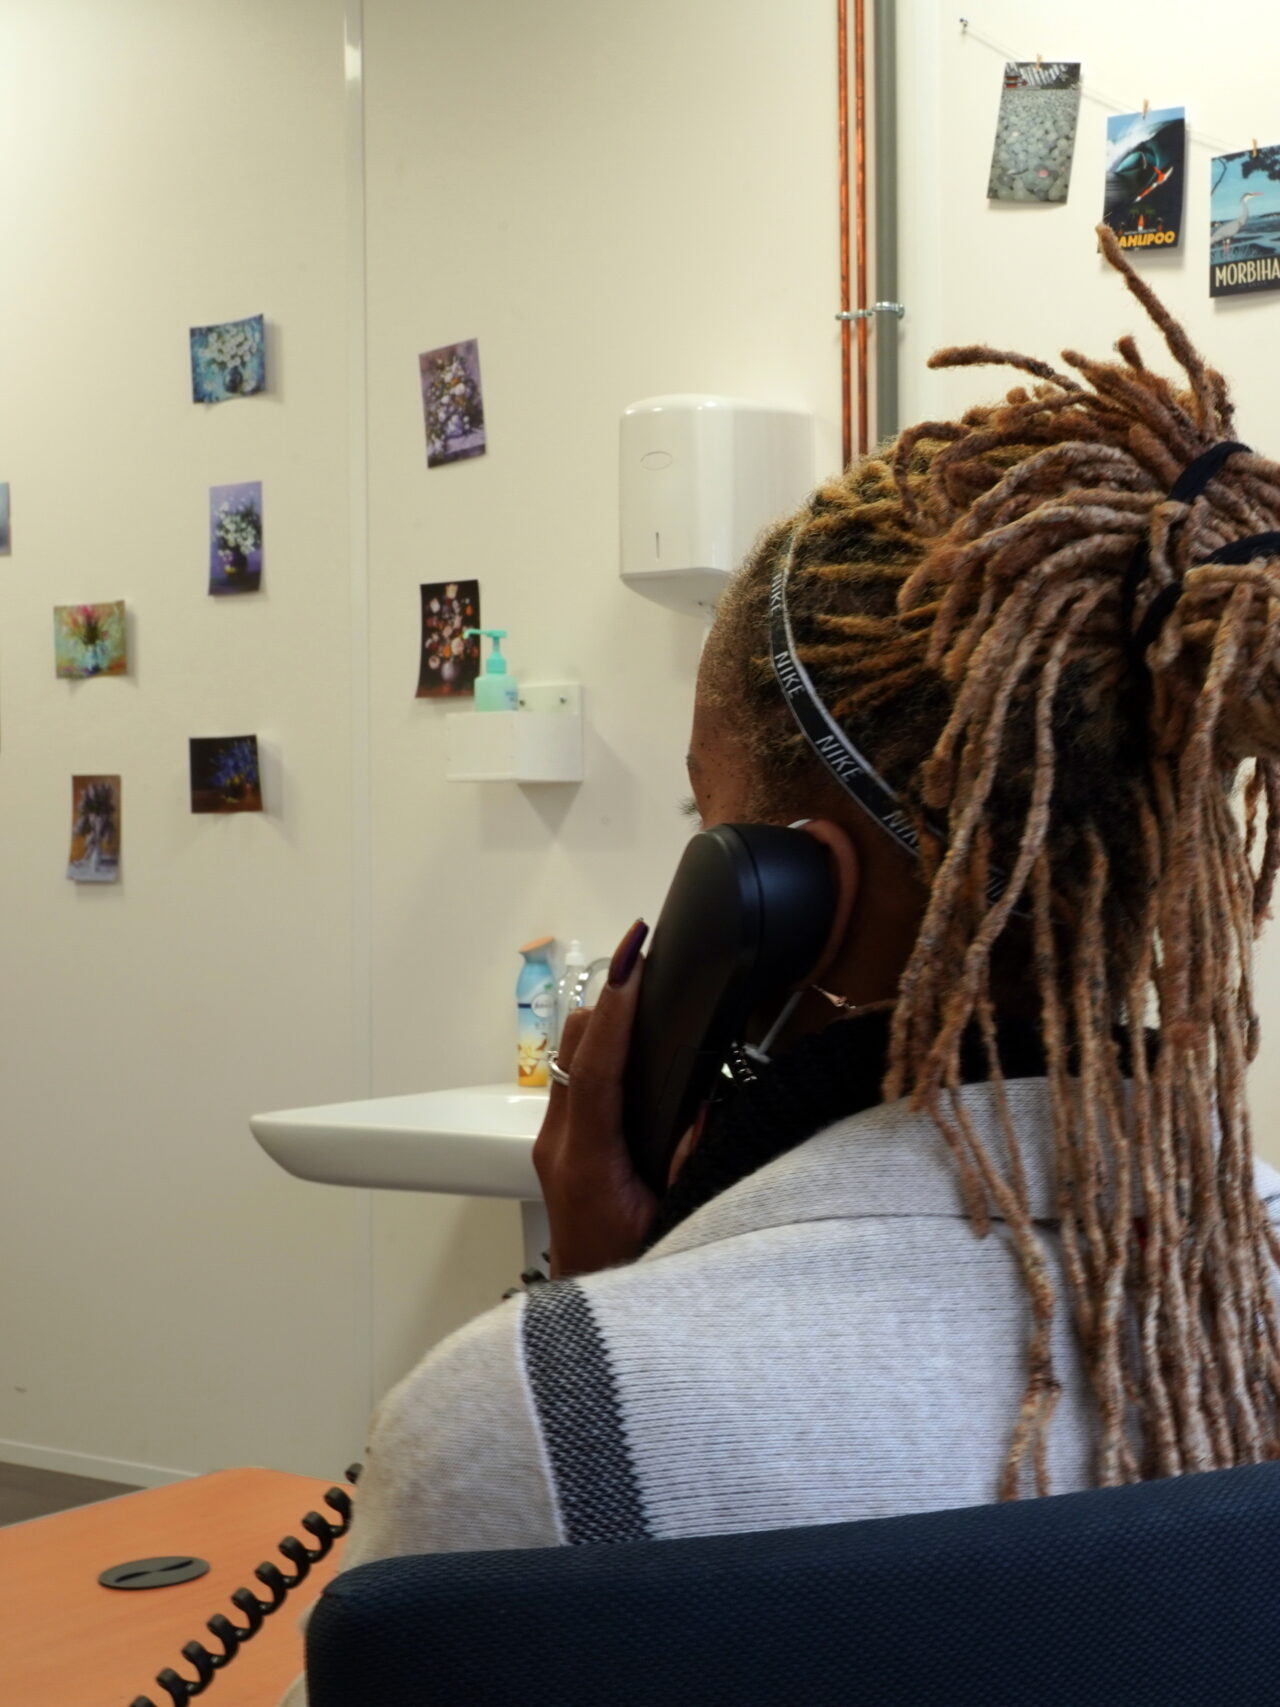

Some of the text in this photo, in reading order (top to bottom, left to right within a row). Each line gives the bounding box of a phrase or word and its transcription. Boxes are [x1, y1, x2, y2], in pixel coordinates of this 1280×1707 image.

[1118, 231, 1175, 248] AHUPOO
[774, 650, 804, 699] NIKE
[815, 734, 864, 783] NIKE
